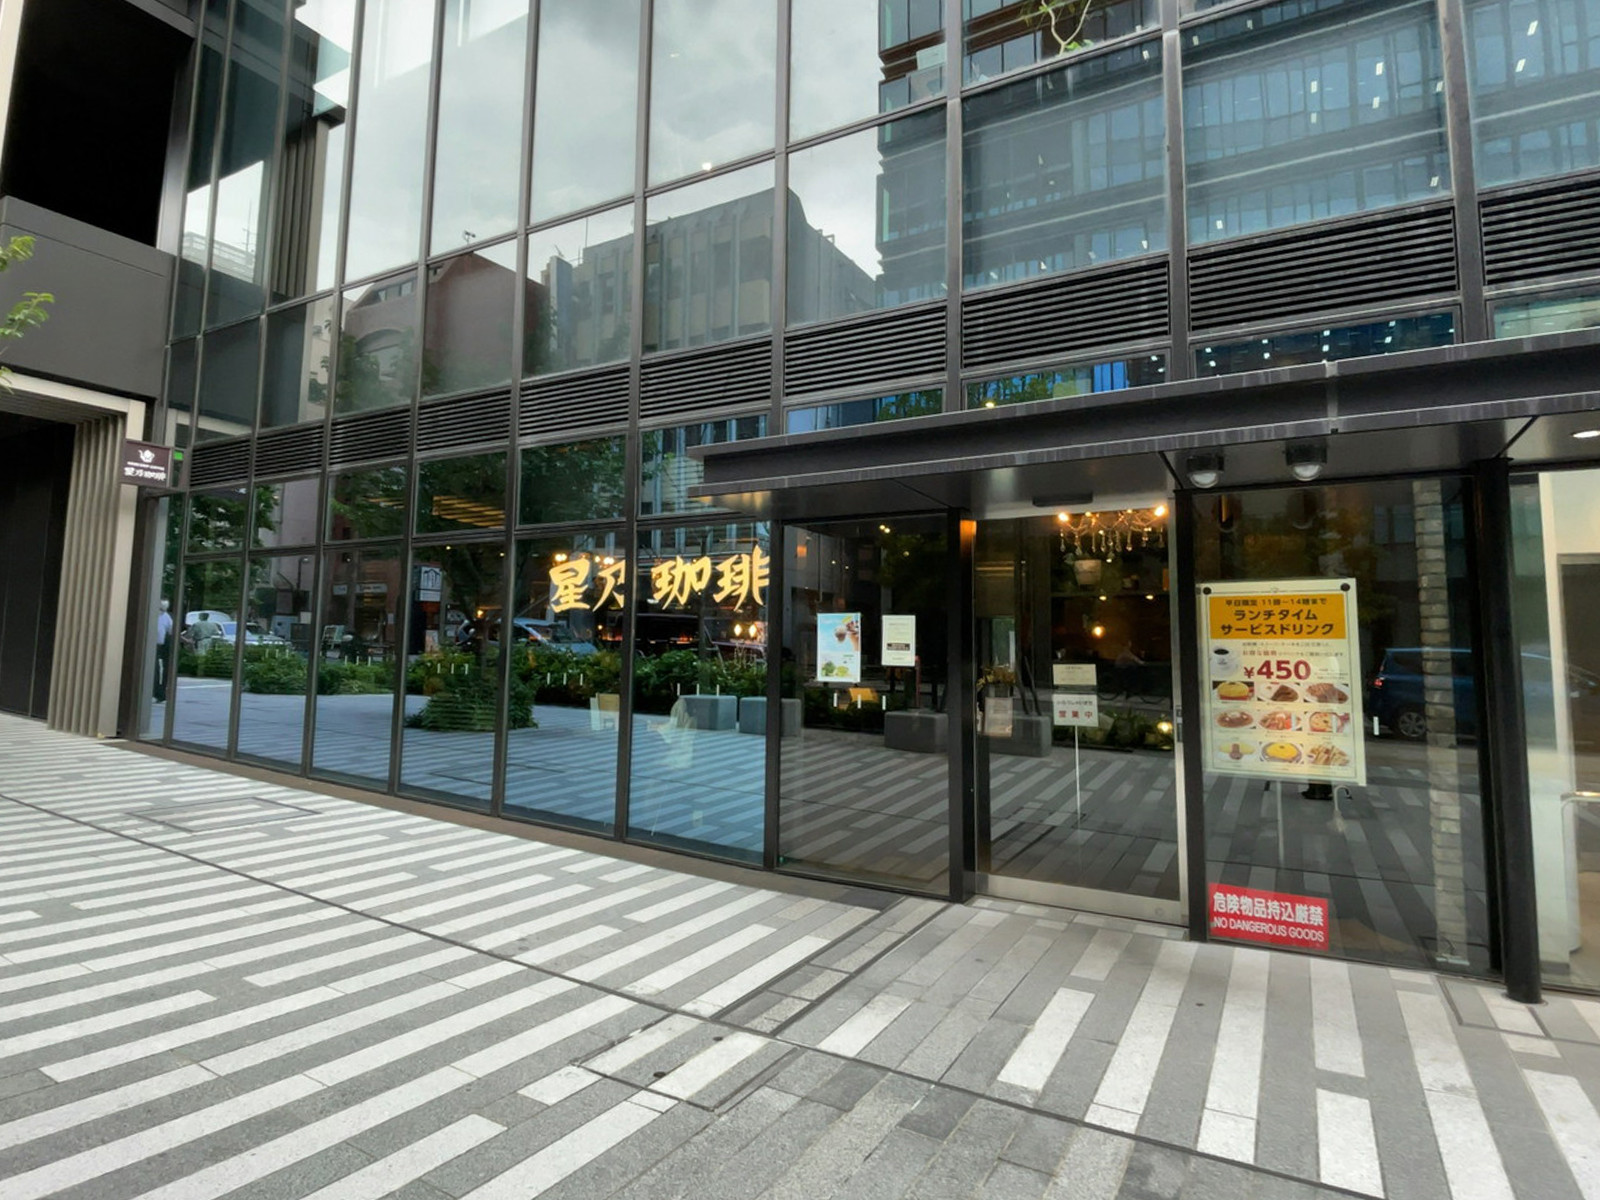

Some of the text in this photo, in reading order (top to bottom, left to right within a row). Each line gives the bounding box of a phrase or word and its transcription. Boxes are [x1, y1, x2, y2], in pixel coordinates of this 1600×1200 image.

[1234, 609, 1318, 621] ランチタイム
[1220, 623, 1334, 635] サービスドリンク
[1244, 659, 1311, 680] ¥450
[1213, 891, 1324, 926] 危険物品持込厳禁
[1213, 917, 1324, 942] NO DANGEROUS GOODS
